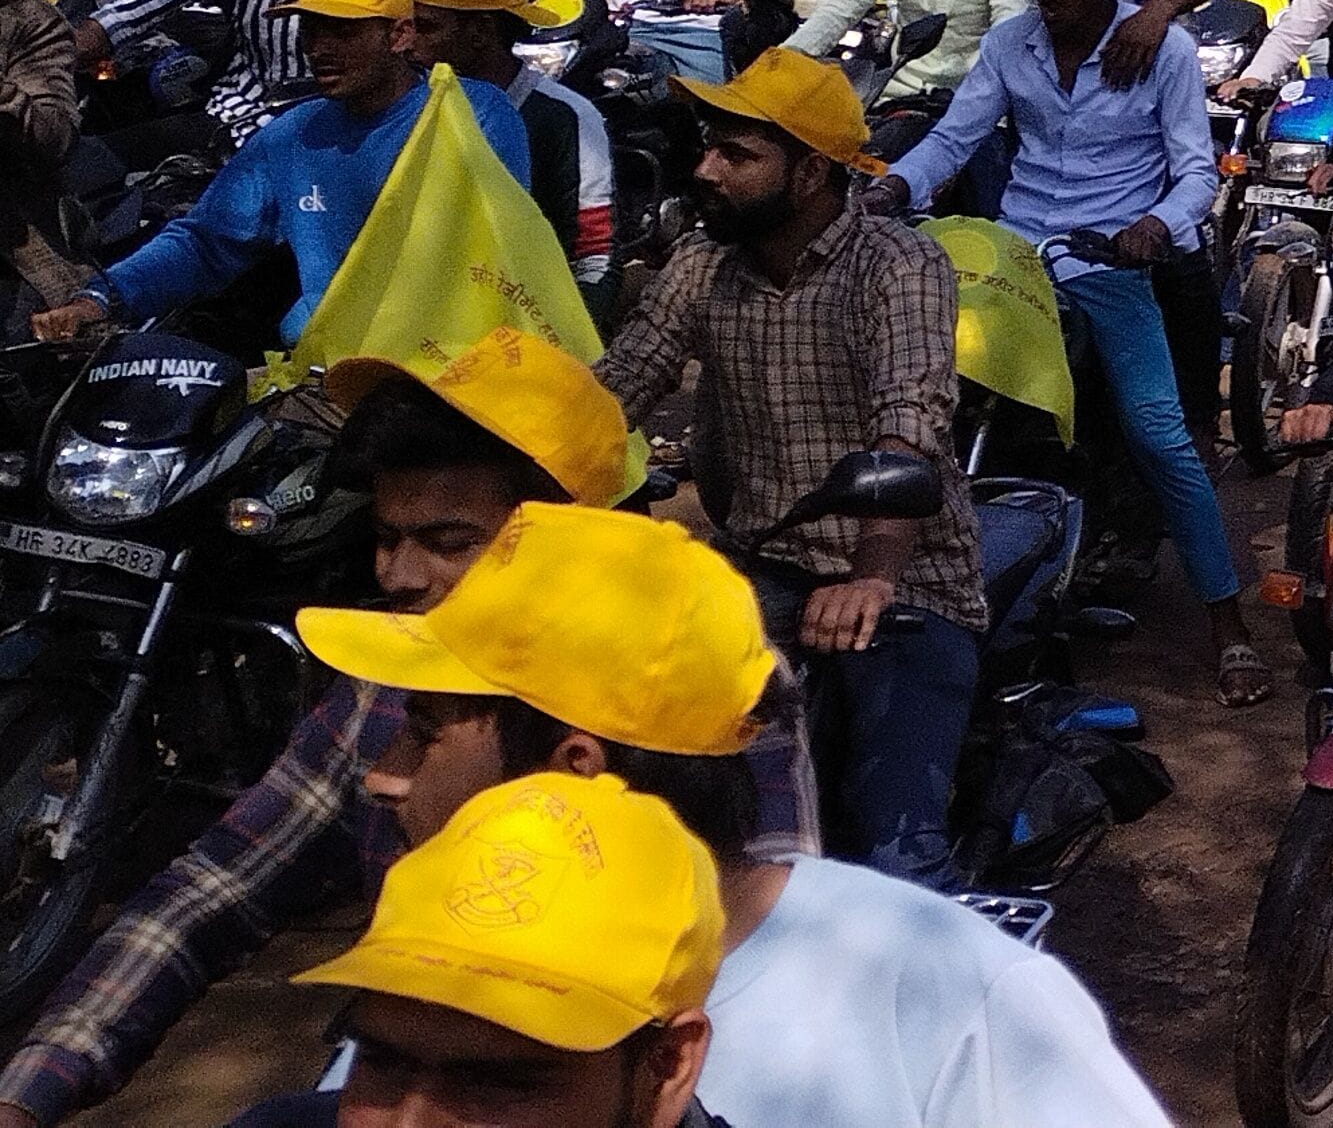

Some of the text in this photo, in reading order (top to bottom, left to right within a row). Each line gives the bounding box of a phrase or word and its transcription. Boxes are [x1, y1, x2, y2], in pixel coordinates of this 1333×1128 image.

[299, 184, 327, 212] ck
[88, 358, 219, 383] INDIAN NAVY
